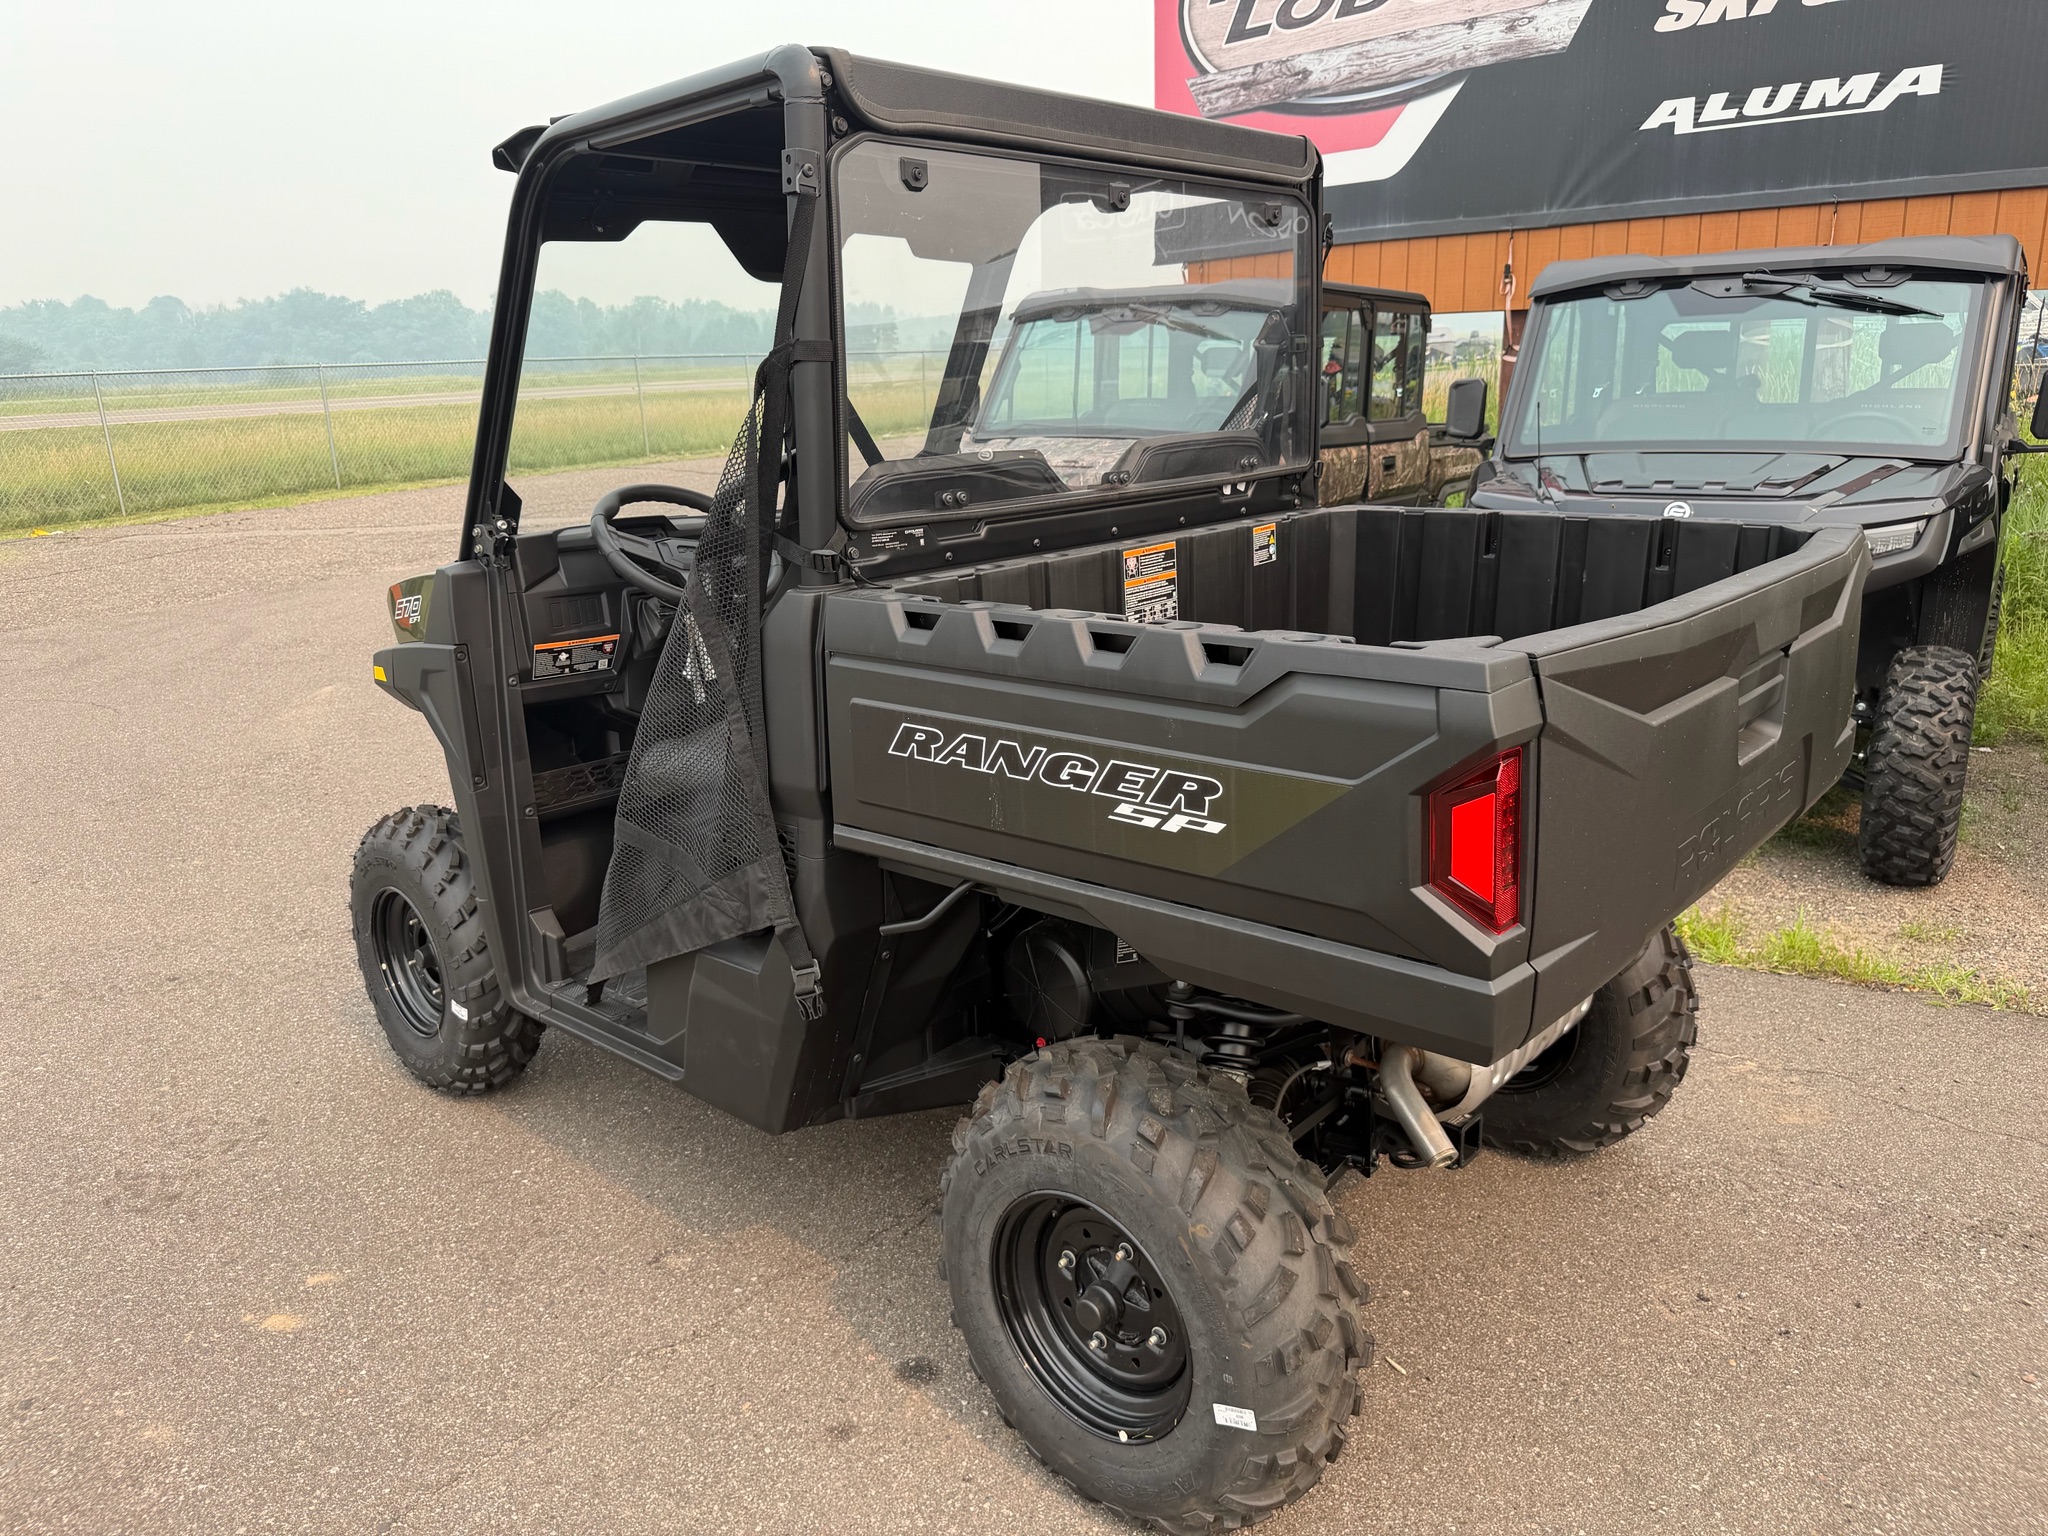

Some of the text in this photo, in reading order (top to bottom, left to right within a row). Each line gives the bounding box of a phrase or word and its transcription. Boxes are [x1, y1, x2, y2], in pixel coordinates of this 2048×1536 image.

[1639, 64, 1943, 135] ALUMA
[395, 595, 422, 619] 570
[888, 723, 1223, 816] RANGER
[1107, 803, 1227, 833] SP
[974, 1137, 1073, 1177] CARLSTAR
